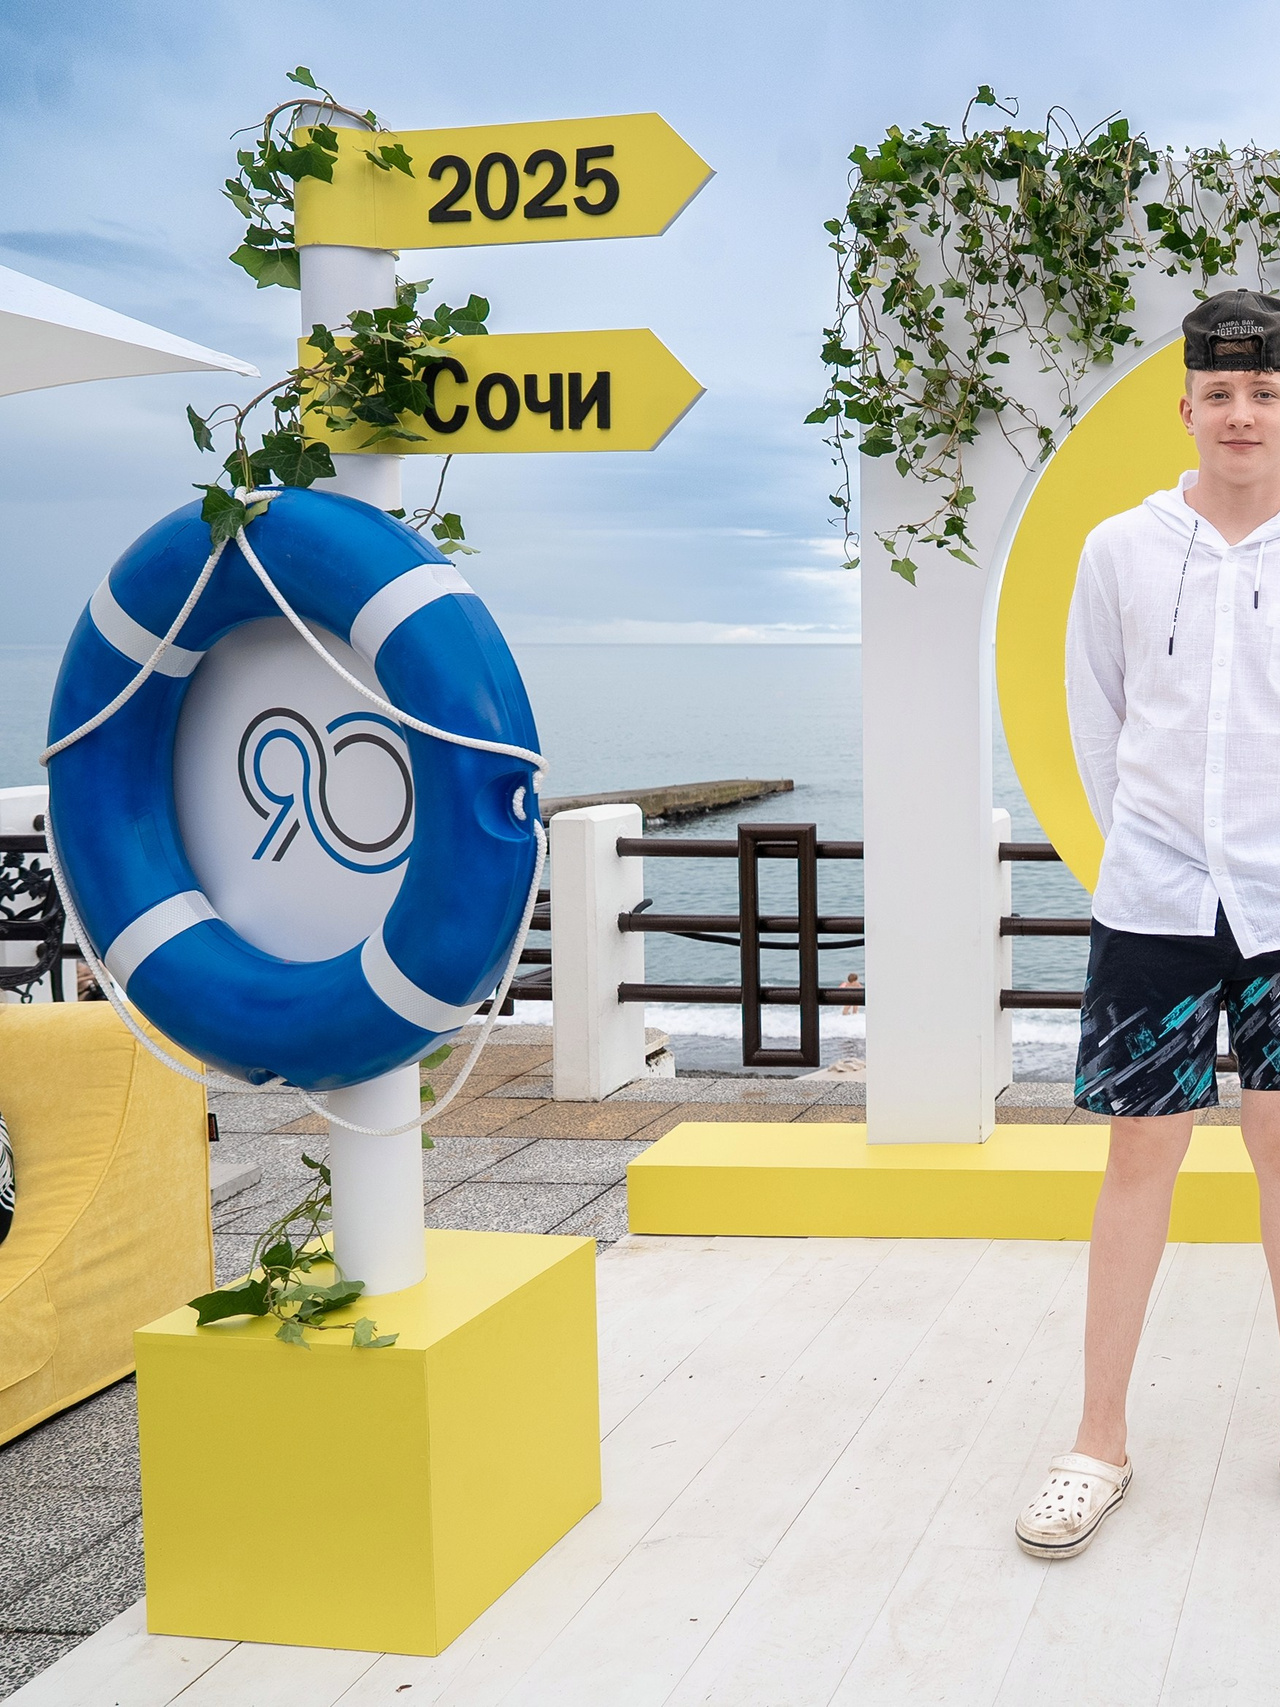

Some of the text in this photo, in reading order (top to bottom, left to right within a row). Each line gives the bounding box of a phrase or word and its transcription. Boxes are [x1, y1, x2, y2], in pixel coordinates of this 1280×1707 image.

[428, 144, 620, 223] 2025
[1217, 320, 1239, 329] TAMPA
[420, 357, 611, 434] Сочи
